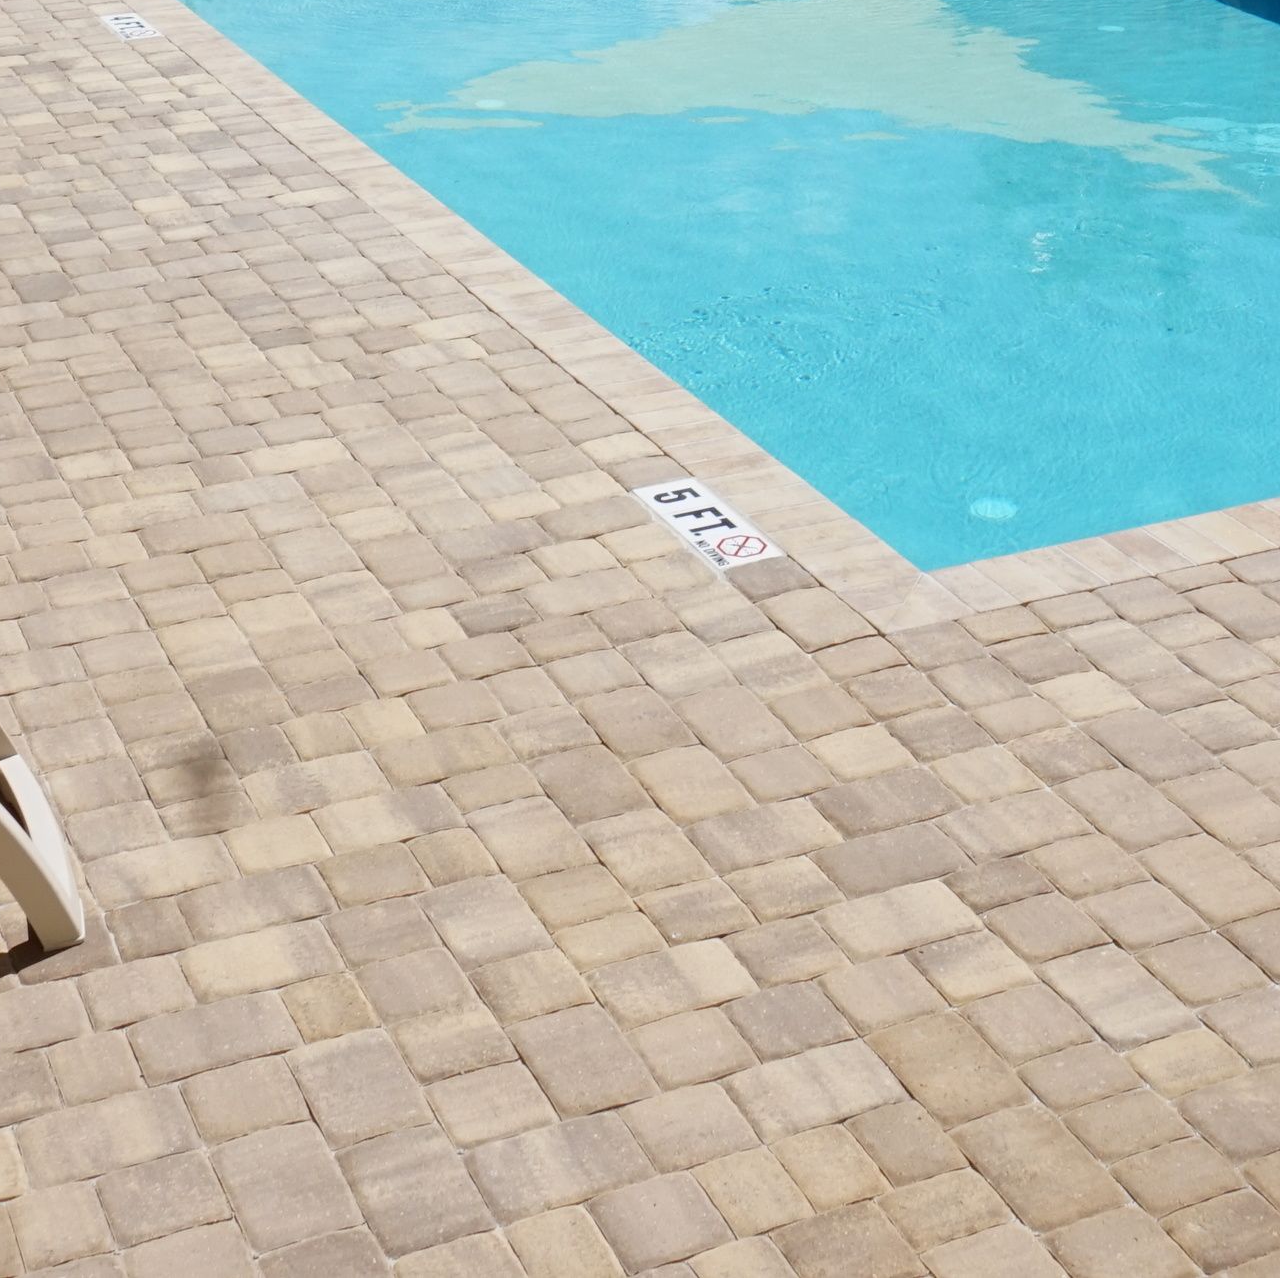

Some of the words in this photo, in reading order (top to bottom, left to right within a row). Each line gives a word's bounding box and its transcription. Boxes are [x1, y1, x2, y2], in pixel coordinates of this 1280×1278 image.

[653, 487, 701, 503] 5
[673, 506, 737, 536] FT.
[696, 539, 710, 549] NO
[703, 547, 730, 567] DIVING
